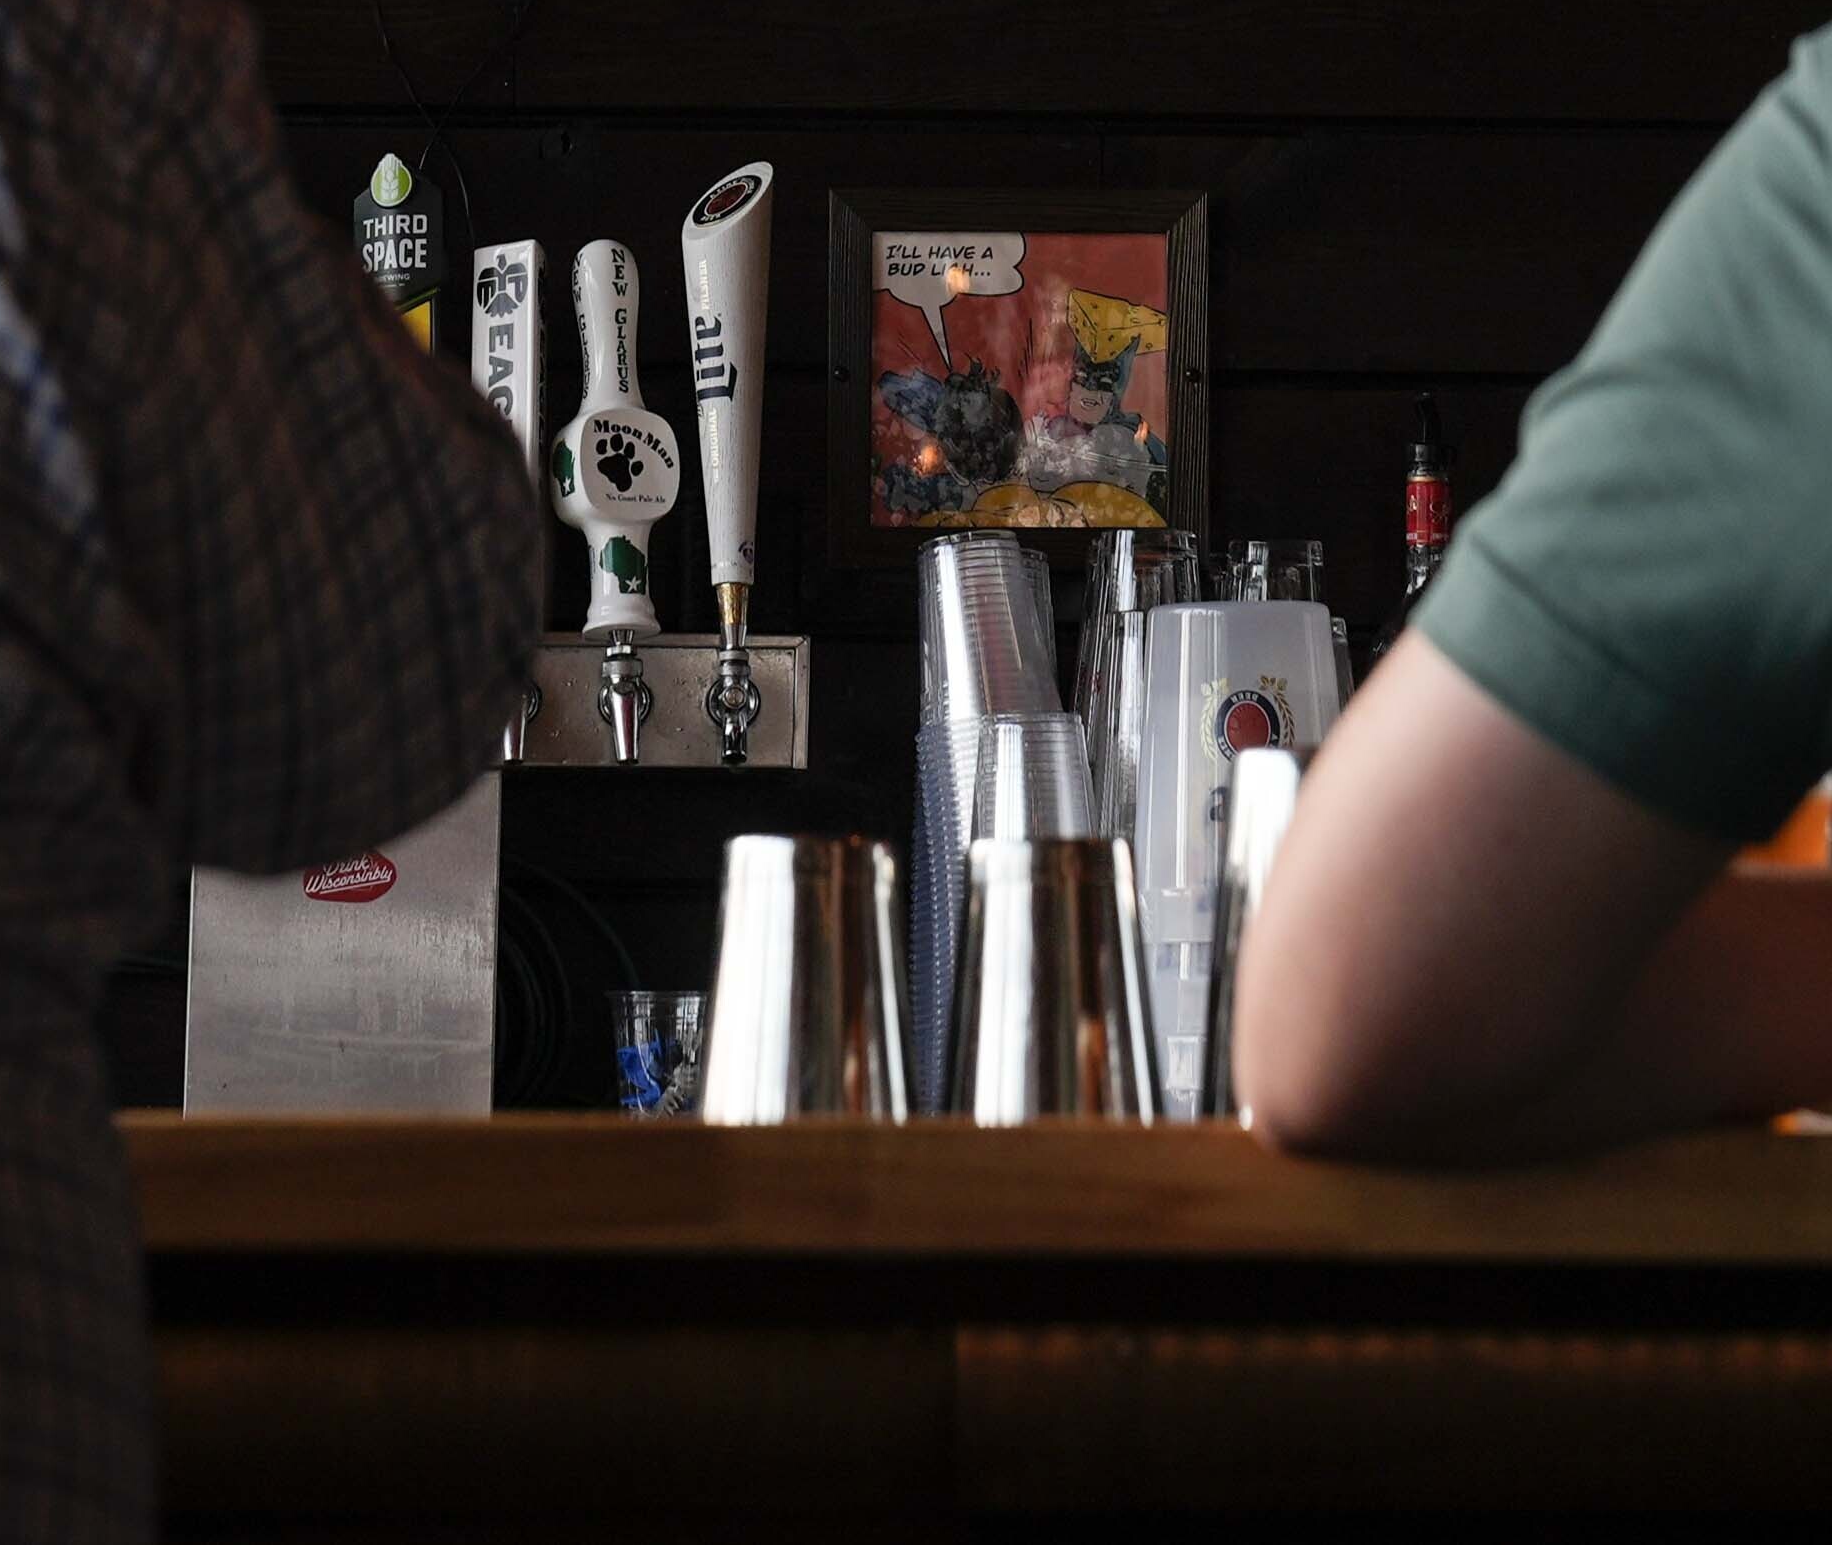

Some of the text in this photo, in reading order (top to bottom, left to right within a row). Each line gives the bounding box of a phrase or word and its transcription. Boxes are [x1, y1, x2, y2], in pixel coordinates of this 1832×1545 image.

[363, 214, 428, 239] THIRD
[362, 238, 427, 273] SPACE
[886, 244, 994, 260] I'LL HAVE A
[887, 263, 926, 277] BUD
[611, 248, 629, 393] NEW GLARUS
[488, 322, 514, 423] EAG
[695, 316, 737, 402] Lite
[593, 419, 674, 469] Moon Man
[305, 866, 393, 893] Wisconsinbly
[323, 854, 370, 876] Drink
